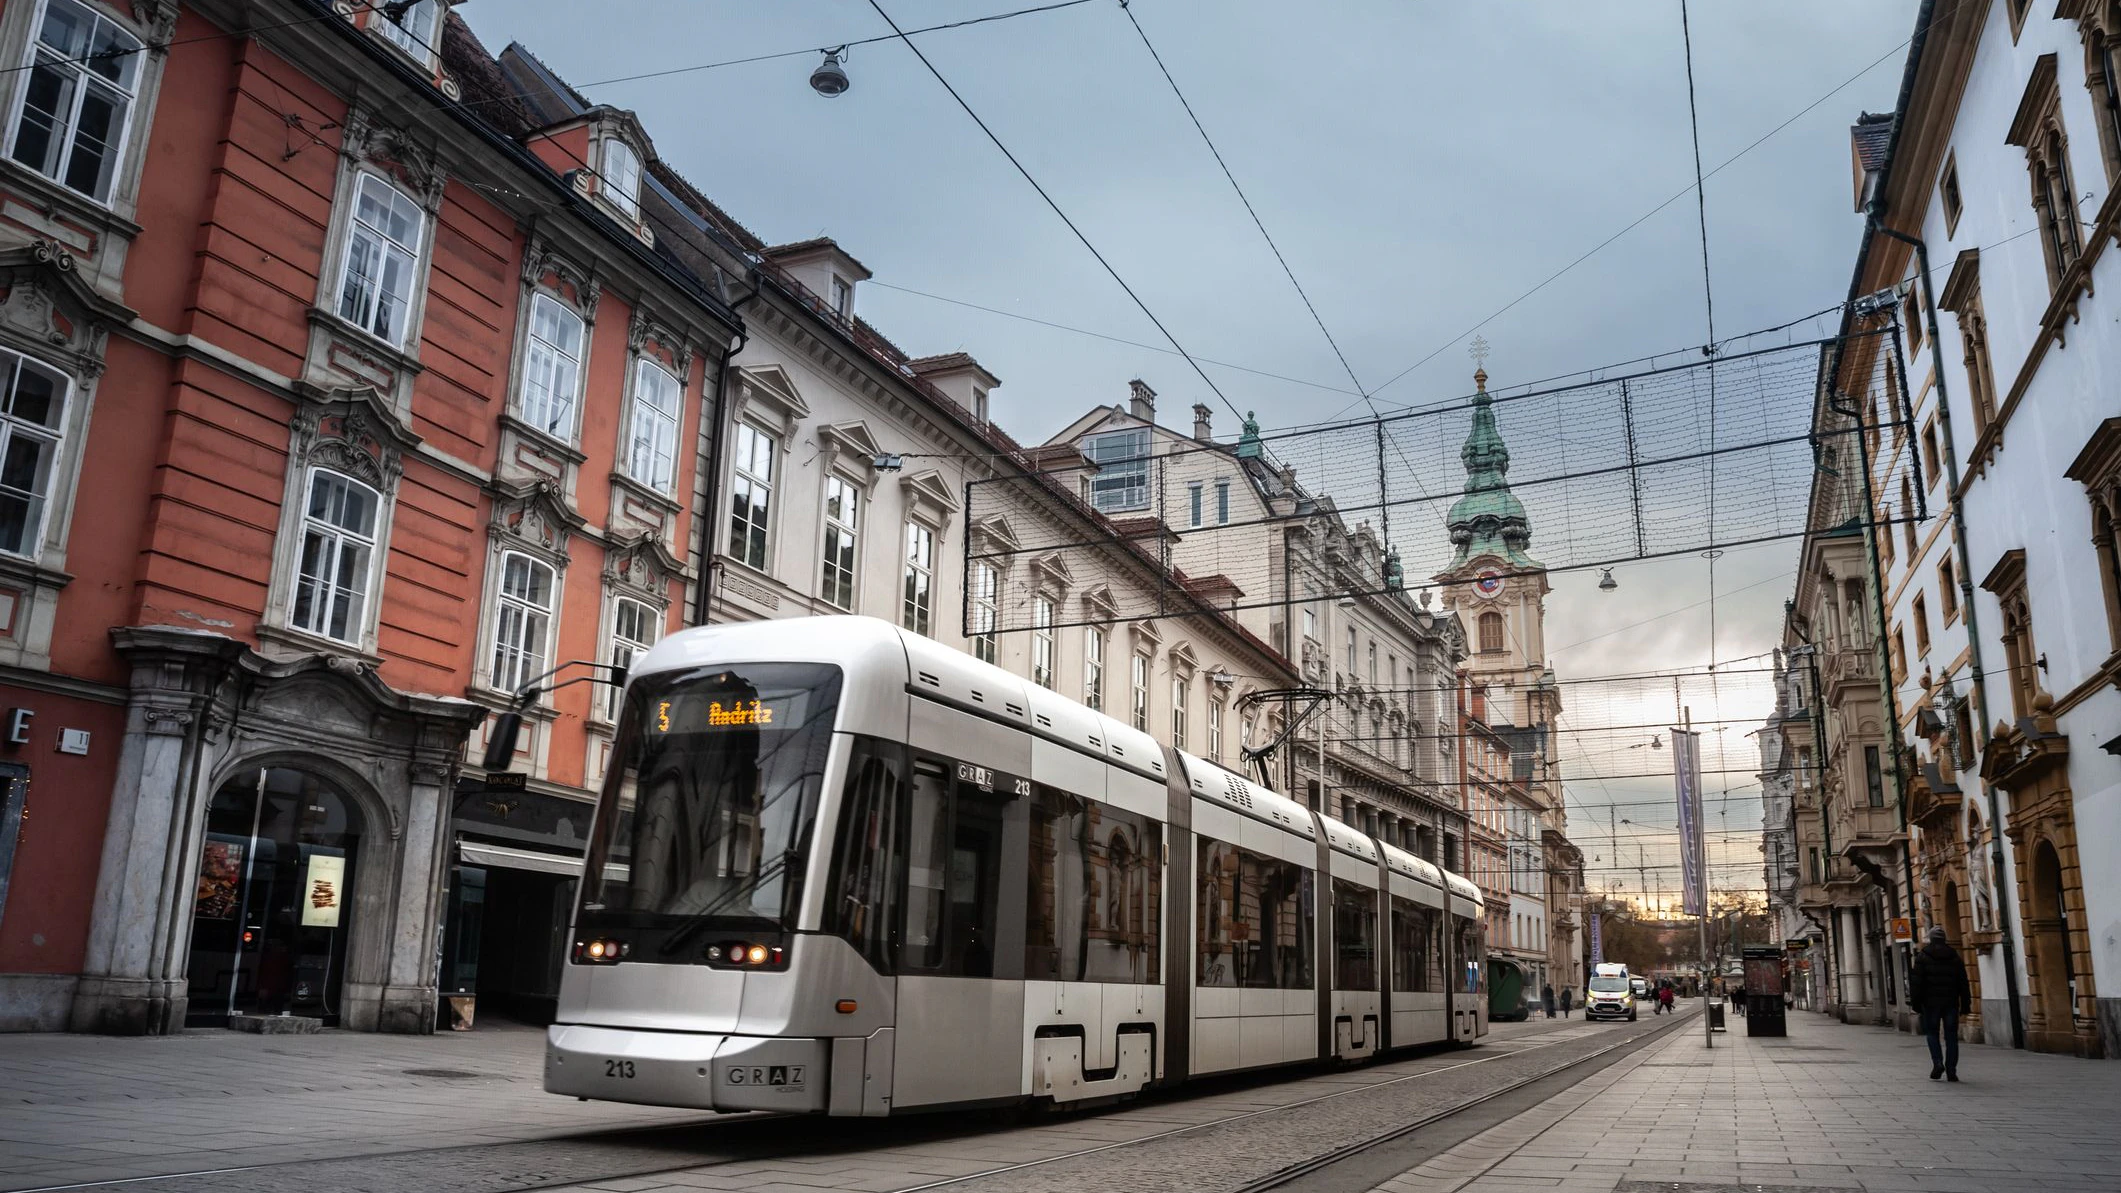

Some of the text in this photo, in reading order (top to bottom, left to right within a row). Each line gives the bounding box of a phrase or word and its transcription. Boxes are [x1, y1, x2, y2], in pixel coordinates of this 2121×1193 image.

[658, 702, 671, 732] 5
[80, 733, 89, 745] 11
[959, 764, 993, 785] GRAZ
[1015, 779, 1031, 797] 213
[605, 1060, 636, 1079] 213
[729, 1067, 805, 1086] GRAZ
